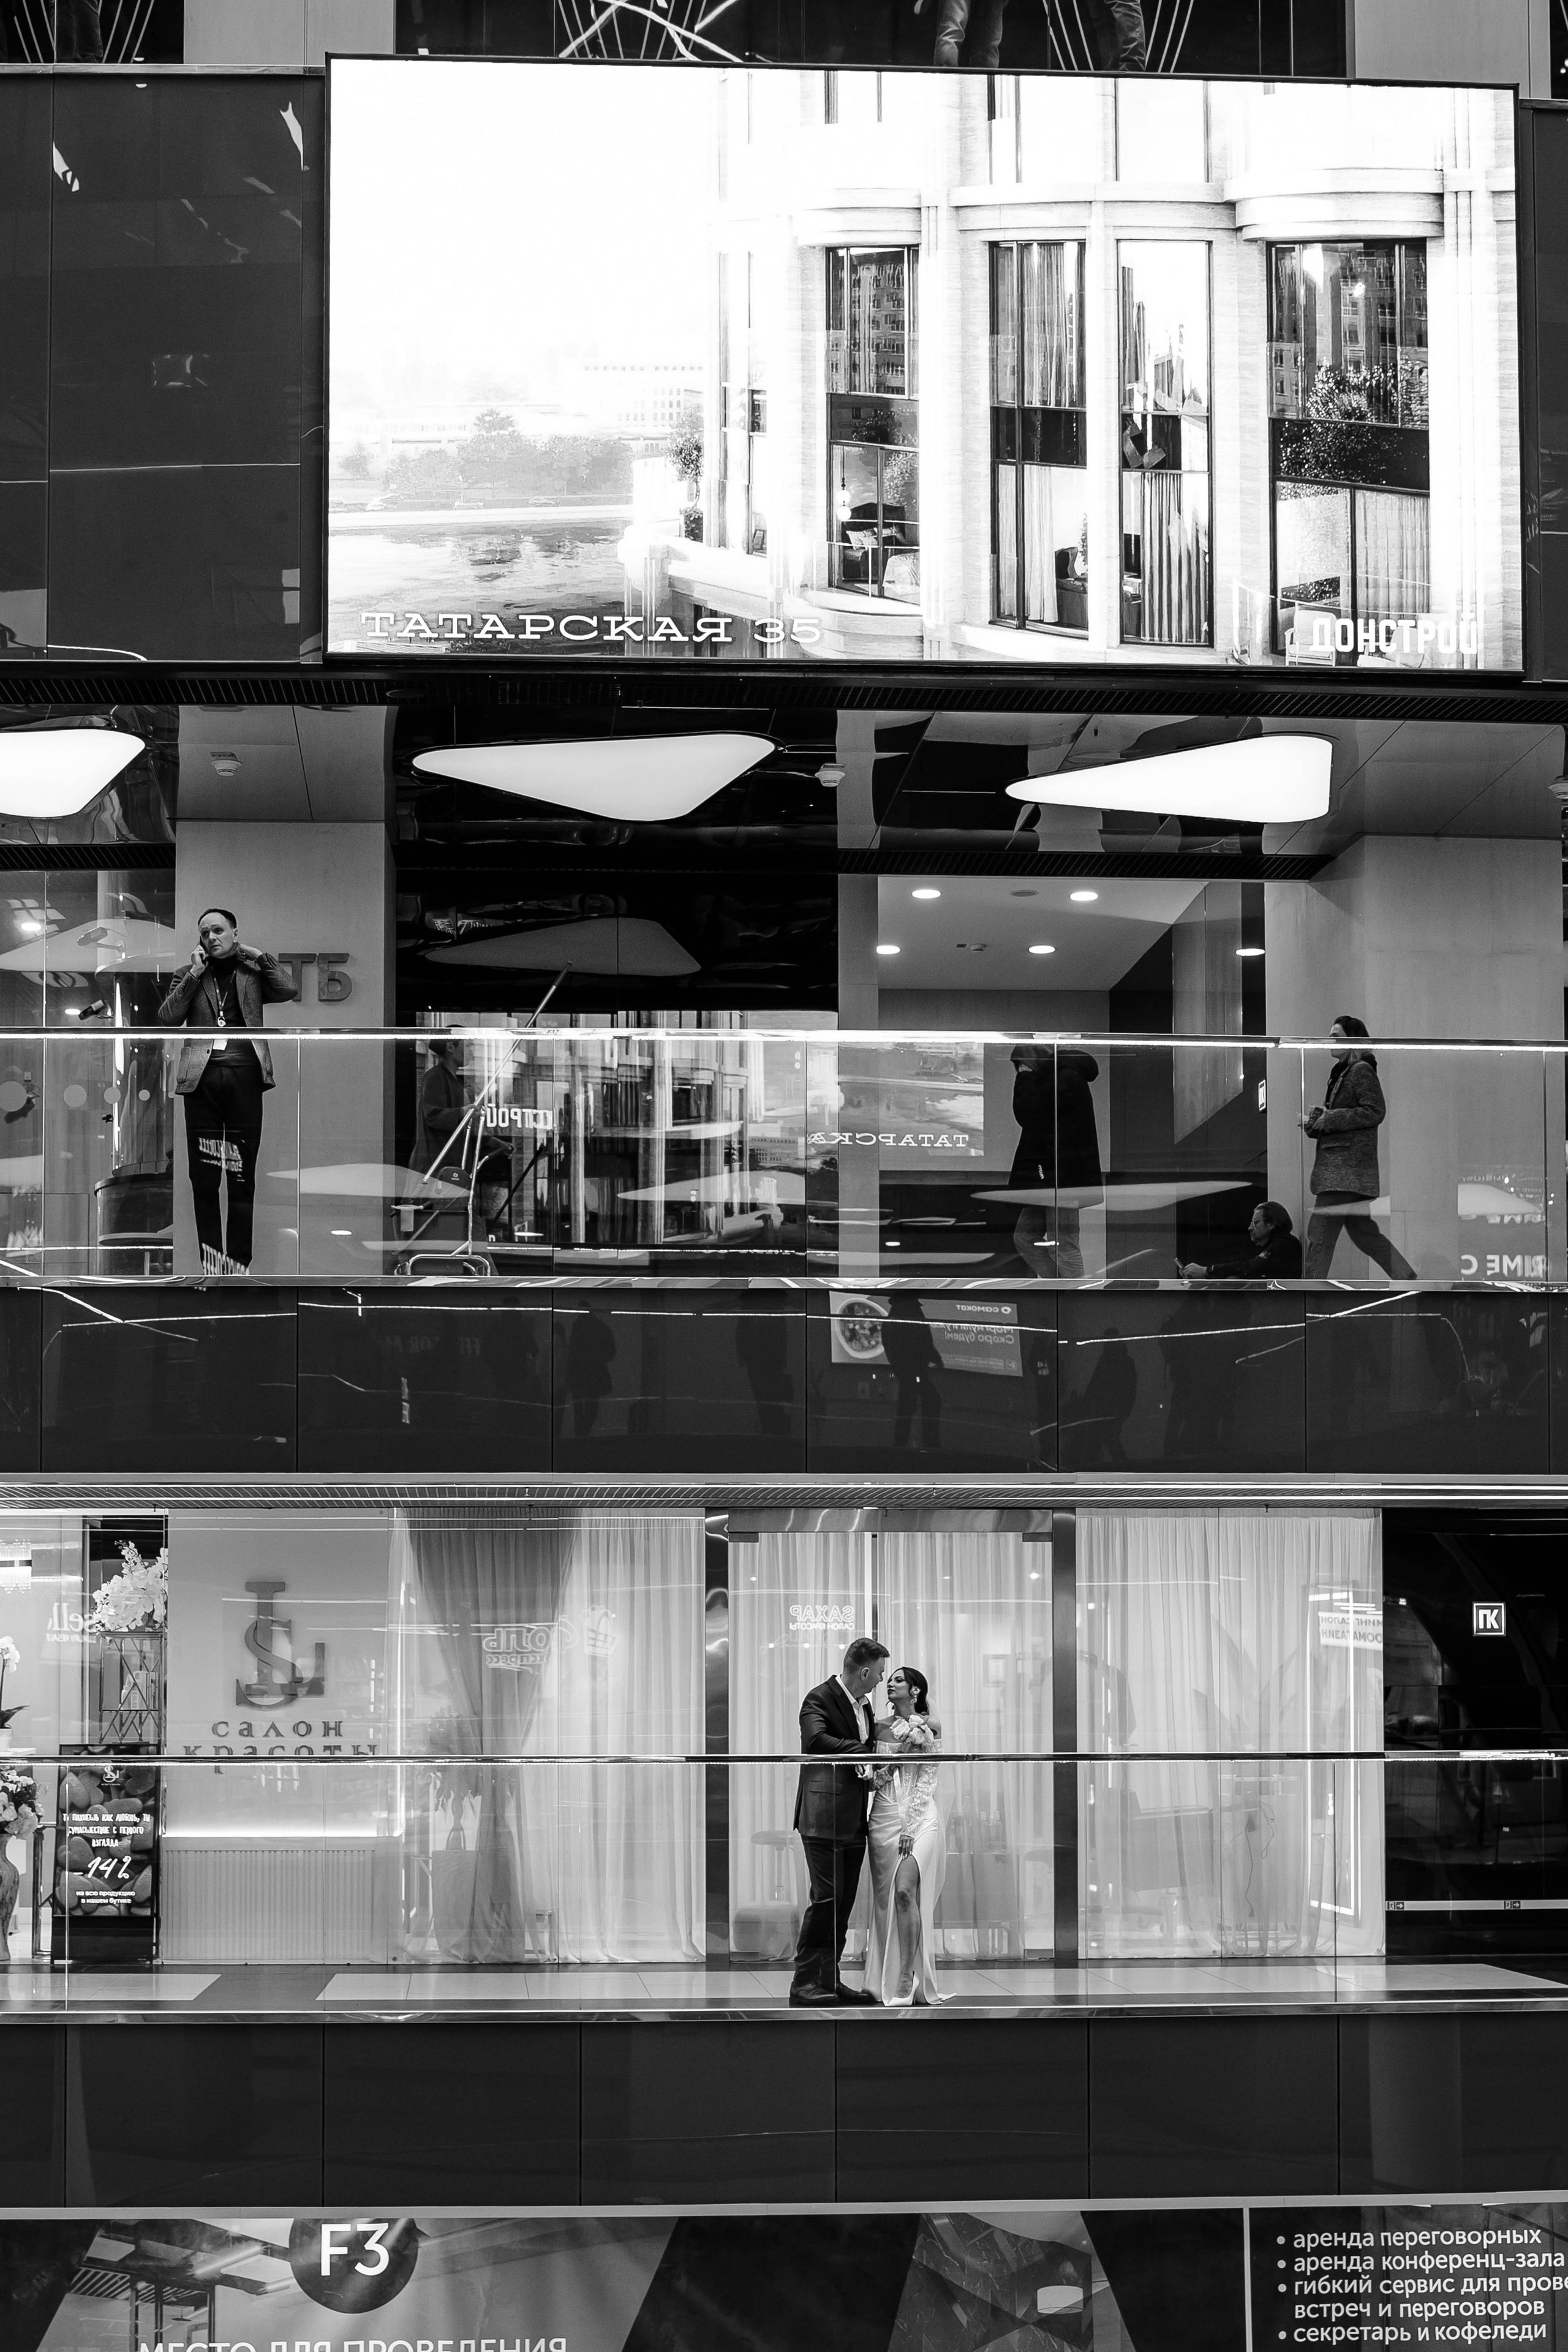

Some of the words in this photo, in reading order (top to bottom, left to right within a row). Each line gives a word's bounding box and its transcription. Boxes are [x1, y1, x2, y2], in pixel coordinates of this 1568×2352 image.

[360, 612, 733, 643] ТАТАРСКАЯ
[753, 618, 821, 644] 35
[1309, 613, 1477, 654] ДОНСТРОЙ
[1479, 1609, 1499, 1629] ПК
[212, 1721, 343, 1737] салон
[320, 2222, 389, 2277] F3
[1294, 2230, 1374, 2252] аренда
[1381, 2229, 1542, 2249] переговорных
[1294, 2255, 1374, 2275] аренда
[1382, 2250, 1565, 2274] конференц-зала
[1294, 2274, 1372, 2295] гибкий
[1379, 2277, 1455, 2297] сервис
[1461, 2276, 1500, 2295] для
[1295, 2302, 1371, 2322] встреч
[1378, 2302, 1392, 2318] и
[1400, 2299, 1545, 2320] переговоров
[1294, 2325, 1411, 2345] секретарь
[1418, 2325, 1430, 2341] и
[1435, 2321, 1547, 2345] кофеледи
